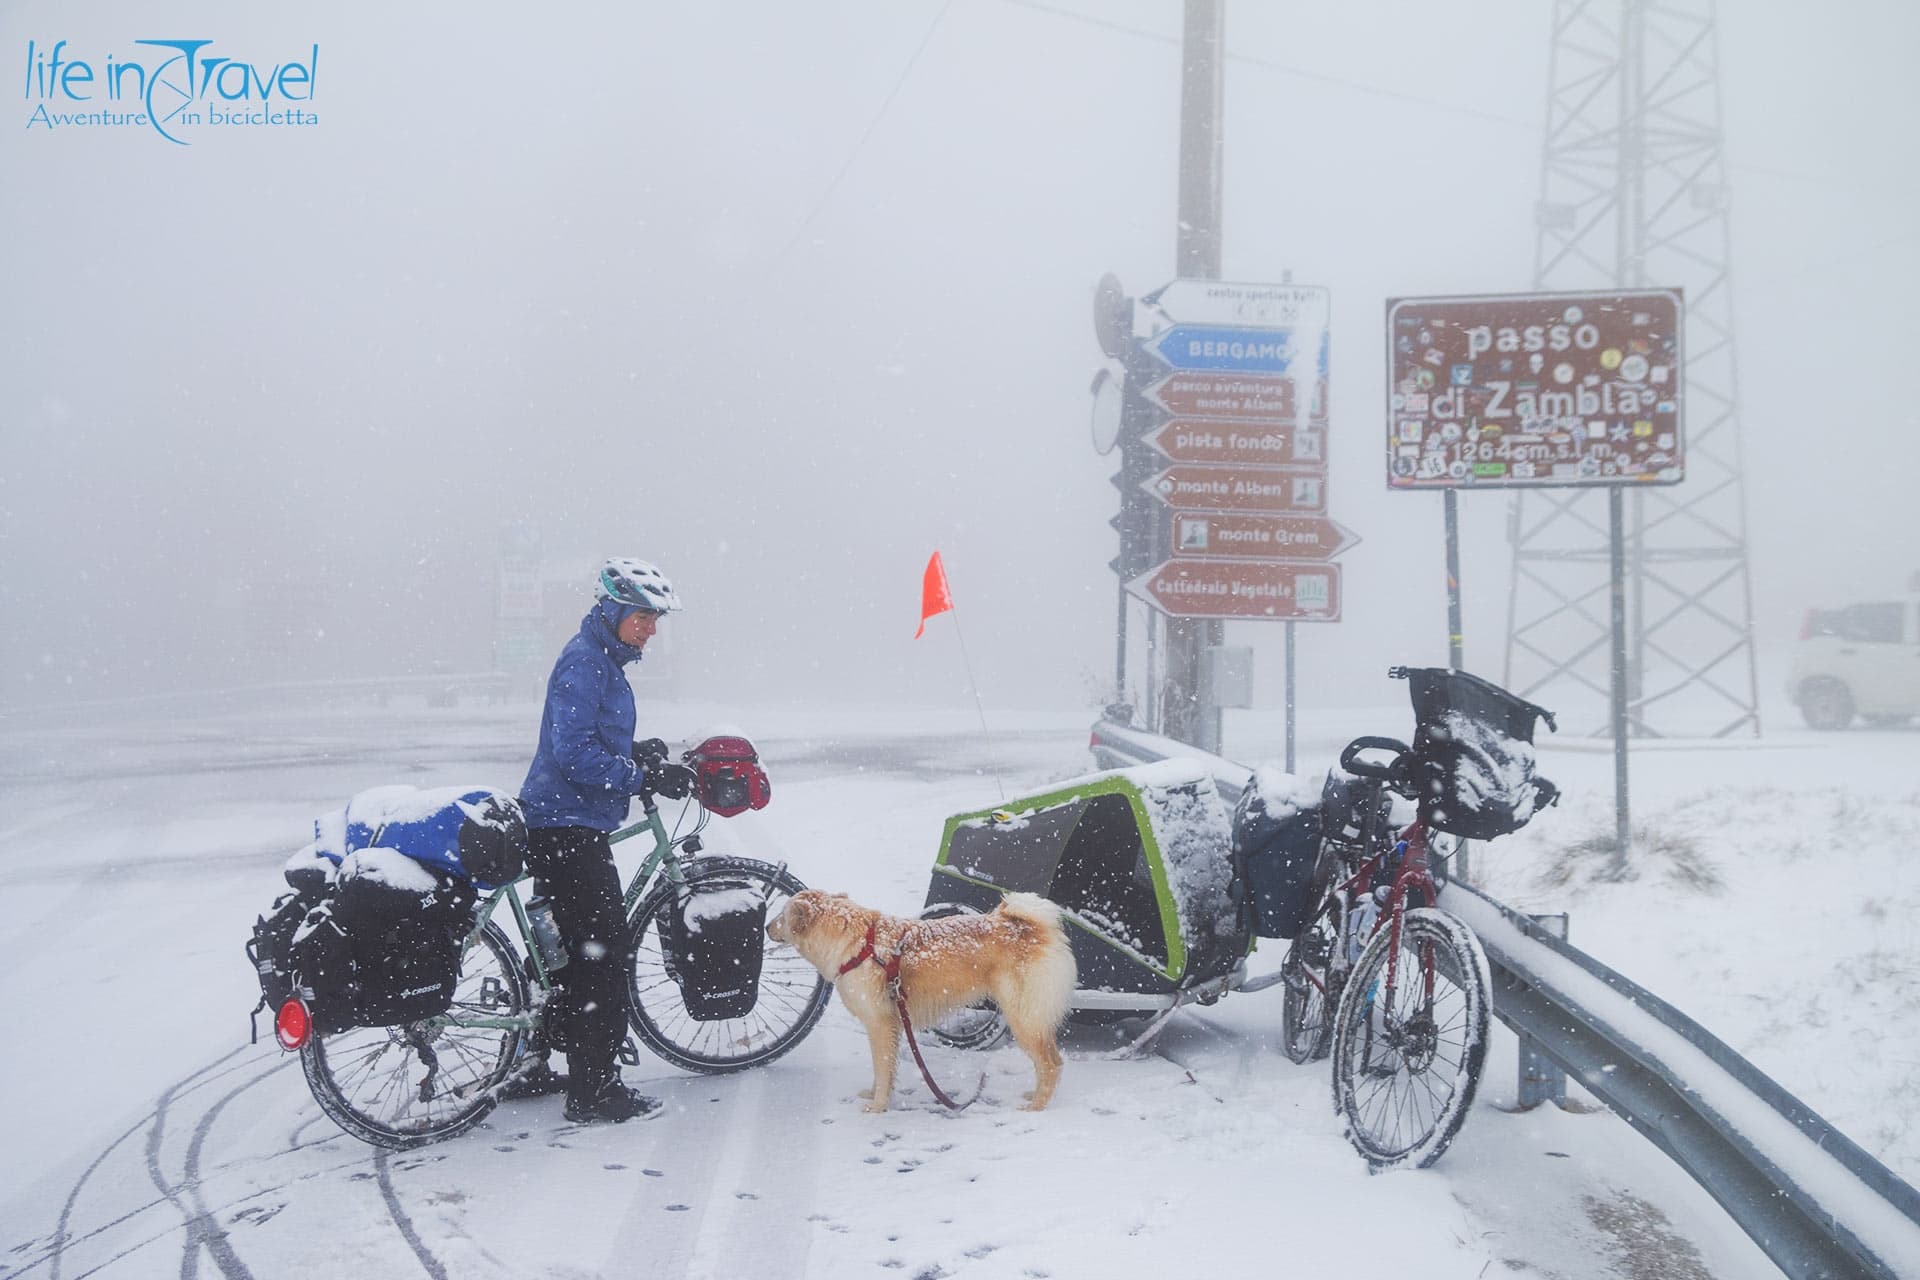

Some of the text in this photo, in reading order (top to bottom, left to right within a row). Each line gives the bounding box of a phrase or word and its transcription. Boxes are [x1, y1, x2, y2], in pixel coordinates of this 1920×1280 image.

[1189, 340, 1294, 359] BERGAMO
[1468, 323, 1600, 361] passo
[1171, 381, 1283, 396] parco avventura
[1196, 398, 1283, 411] monte Alben
[1432, 386, 1465, 419] di
[1485, 380, 1640, 418] Zambla
[1176, 431, 1283, 451] pista fondo
[1177, 480, 1282, 496] monte Alben
[1218, 527, 1320, 545] monte Grem
[411, 983, 442, 996] CROSSO
[712, 988, 741, 999] CROSSO
